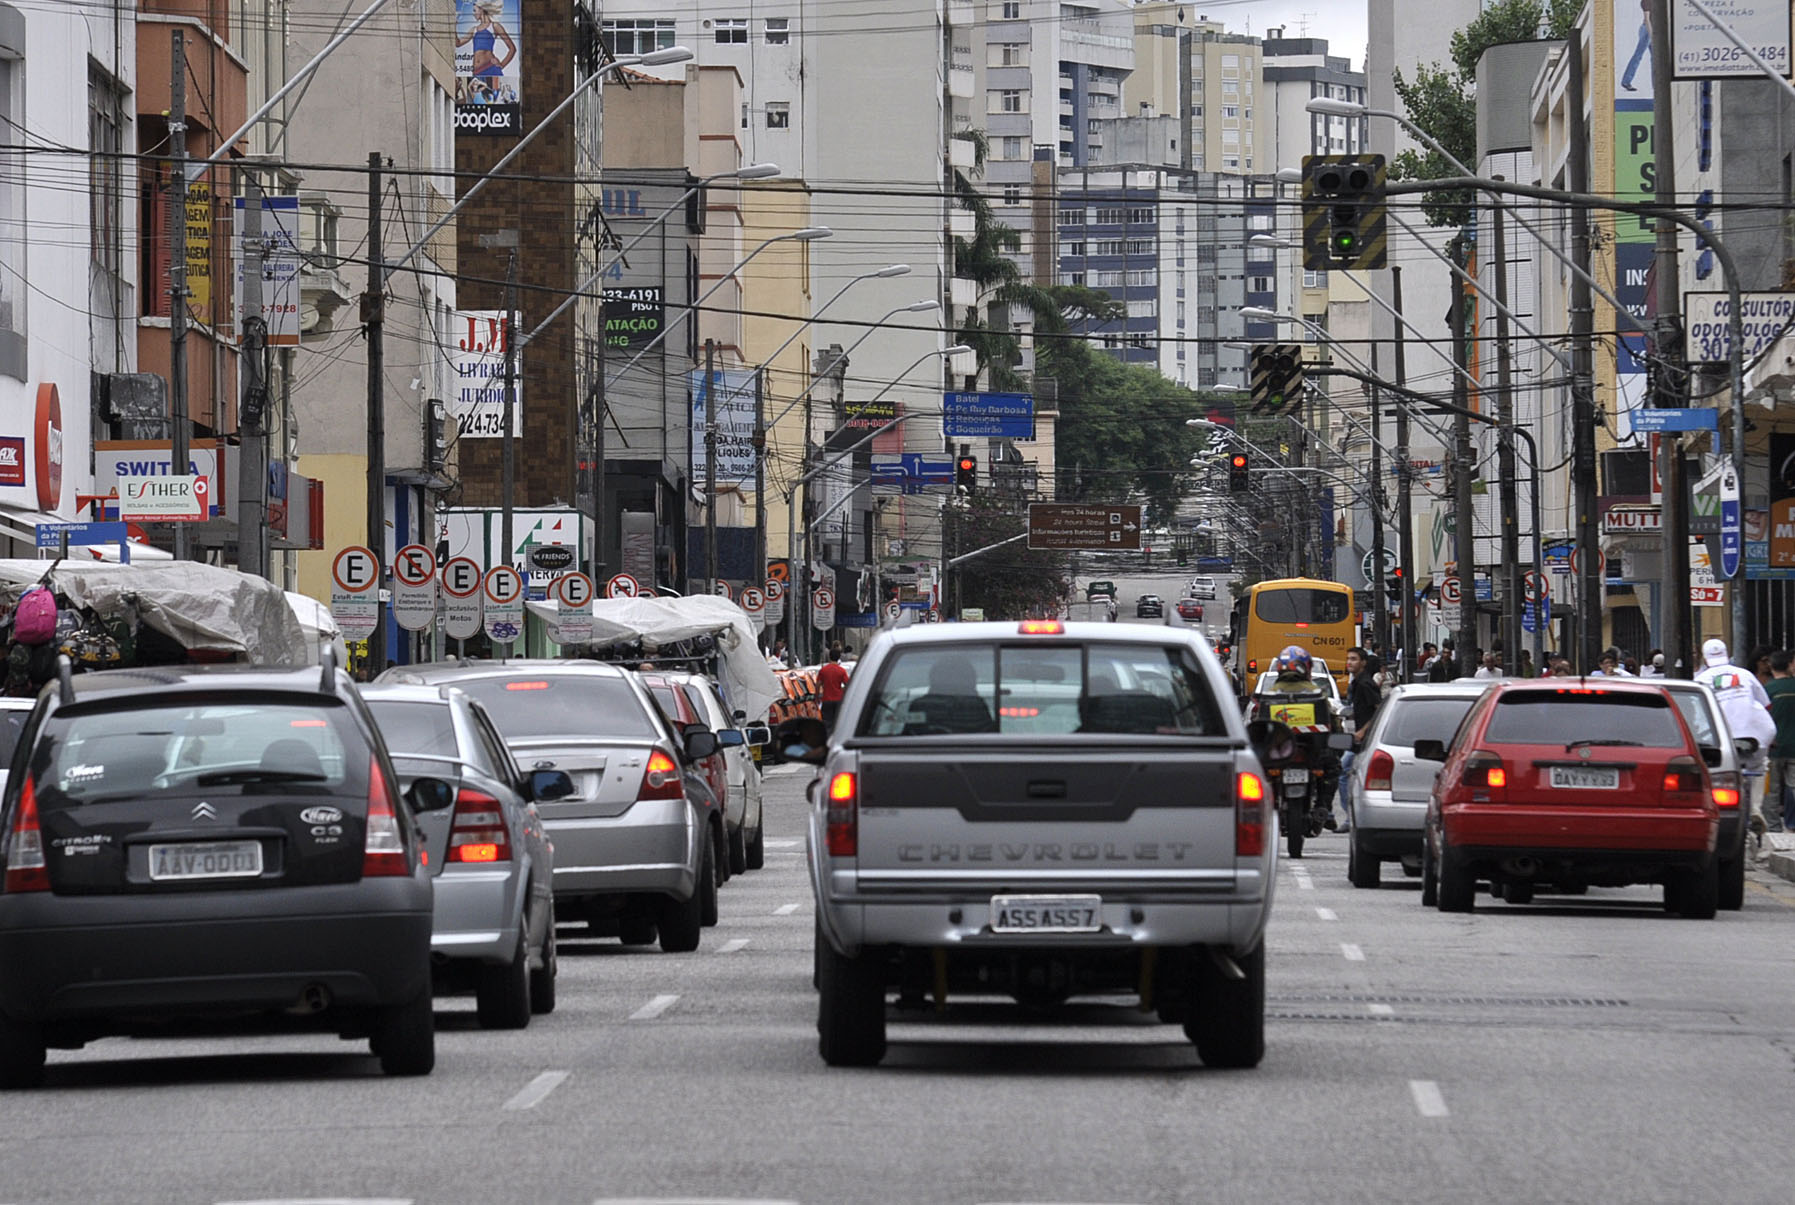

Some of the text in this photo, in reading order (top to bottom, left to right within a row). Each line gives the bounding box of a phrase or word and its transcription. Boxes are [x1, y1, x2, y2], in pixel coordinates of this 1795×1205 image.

[1679, 46, 1786, 63] (41) 3026-484
[956, 395, 979, 403] Batel
[988, 406, 1027, 415] Barbosa
[115, 461, 200, 476] SWITA
[128, 481, 189, 499] ESTHER
[407, 553, 422, 577] E
[541, 553, 571, 561] FRIENDS
[347, 555, 363, 583] E
[454, 565, 469, 588] E
[496, 573, 509, 596] E
[569, 579, 581, 600] E
[1313, 637, 1345, 645] CN 601
[898, 842, 1193, 862] CHEVROLET
